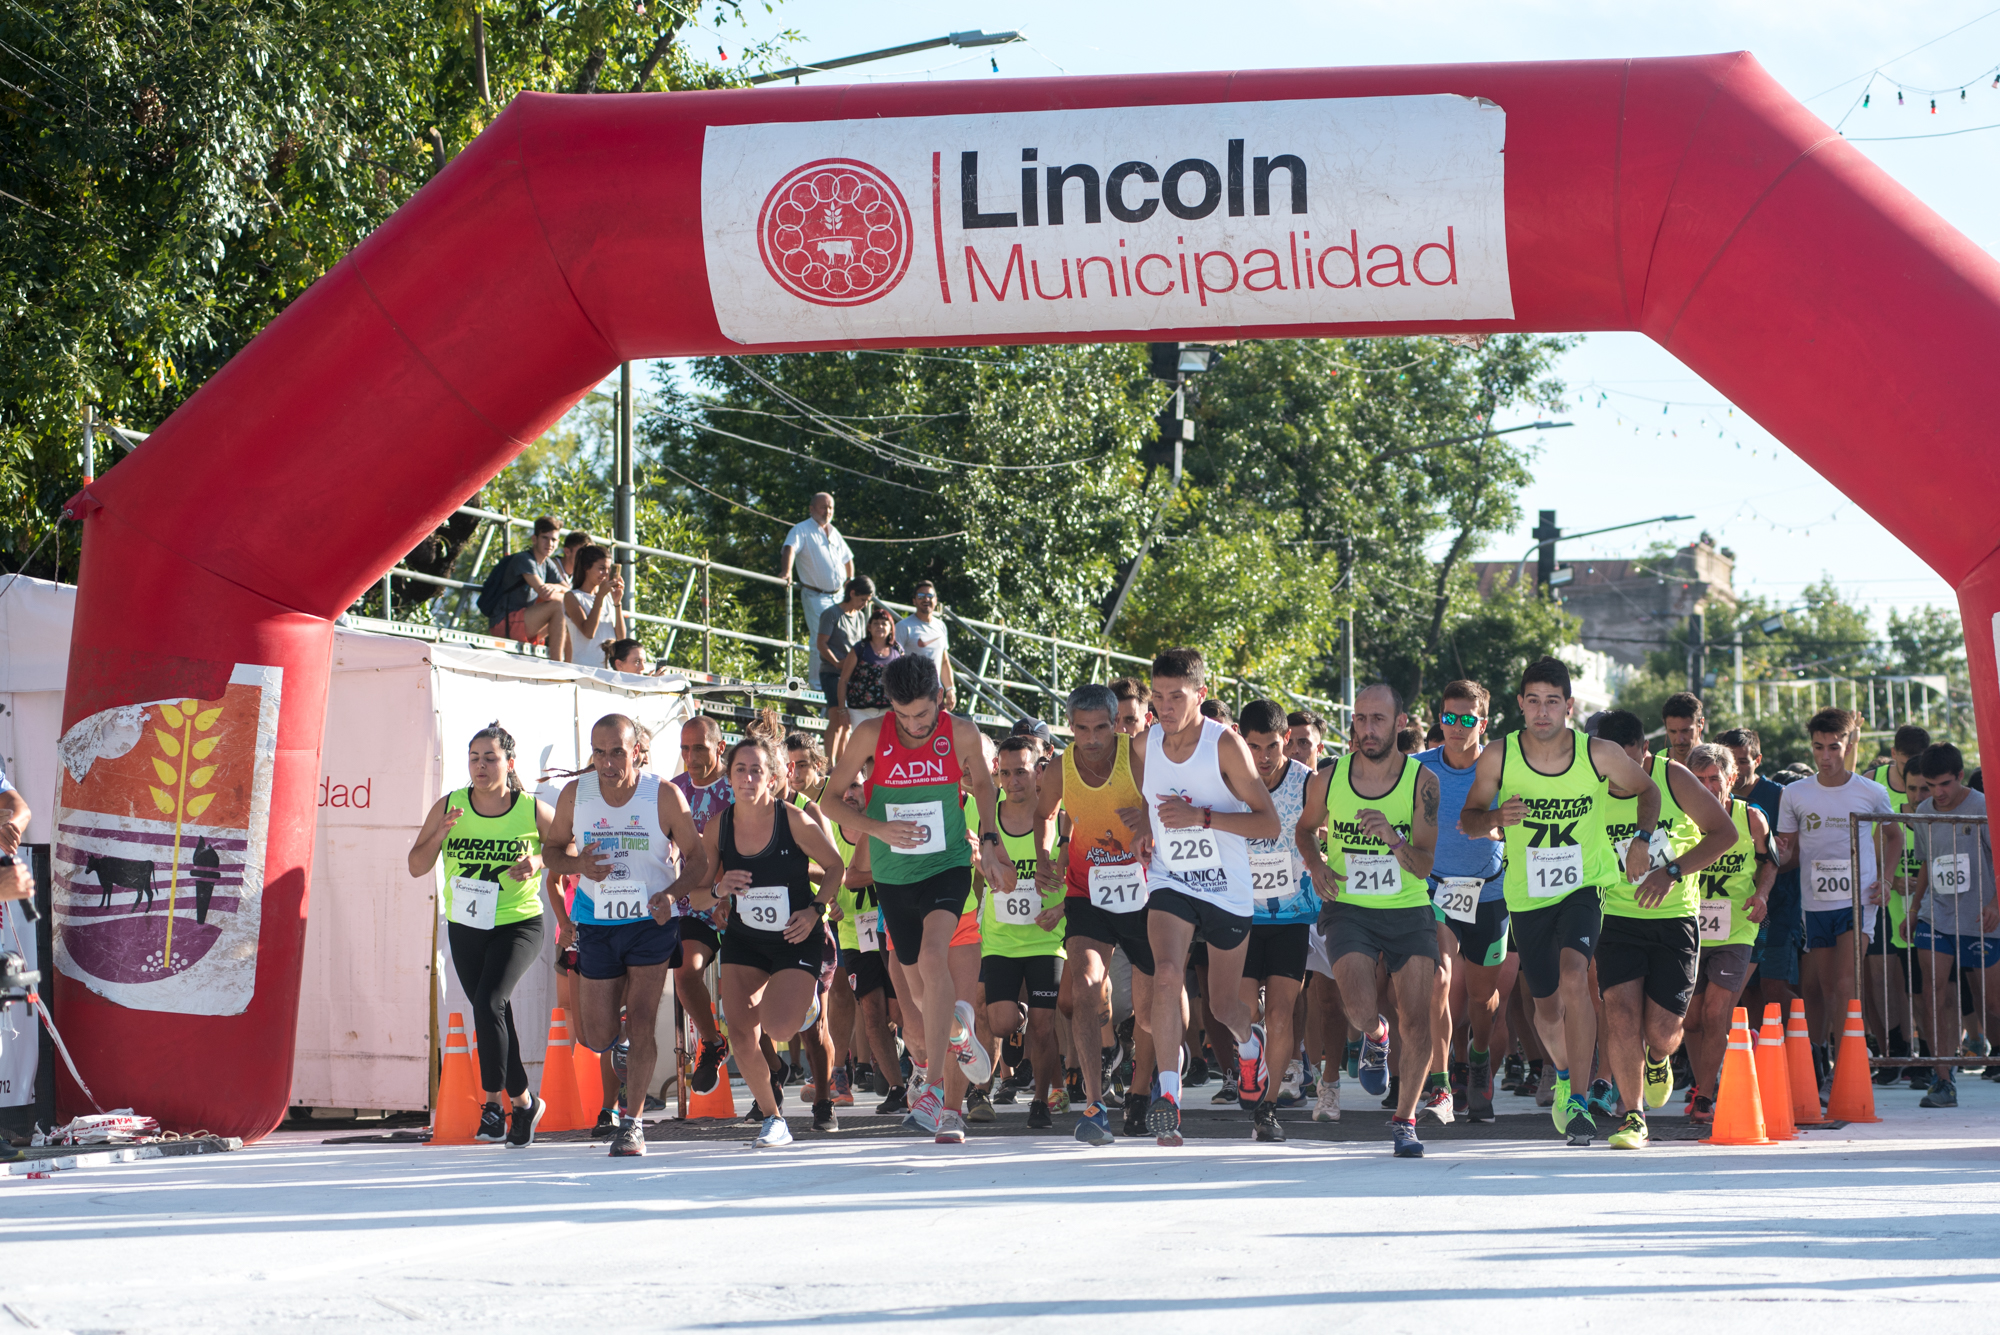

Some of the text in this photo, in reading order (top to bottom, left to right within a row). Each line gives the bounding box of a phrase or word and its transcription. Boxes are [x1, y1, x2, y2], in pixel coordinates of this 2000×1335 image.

[961, 138, 1308, 230] Lincoln
[964, 226, 1458, 306] Municipalidad
[888, 759, 943, 779] ADN
[621, 835, 649, 850] traviesa
[1523, 820, 1580, 848] 7K
[447, 836, 530, 853] MARATÓN
[1170, 839, 1213, 860] 226
[1251, 869, 1289, 890] 225
[1354, 868, 1396, 890] 214
[1537, 866, 1577, 887] 126
[1817, 877, 1850, 893] 200
[1937, 870, 1966, 887] 186
[1098, 882, 1140, 906] 217
[1441, 892, 1474, 914] 229
[466, 899, 477, 917] 4
[603, 901, 643, 919] 104
[752, 906, 778, 924] 39
[1006, 898, 1031, 916] 68
